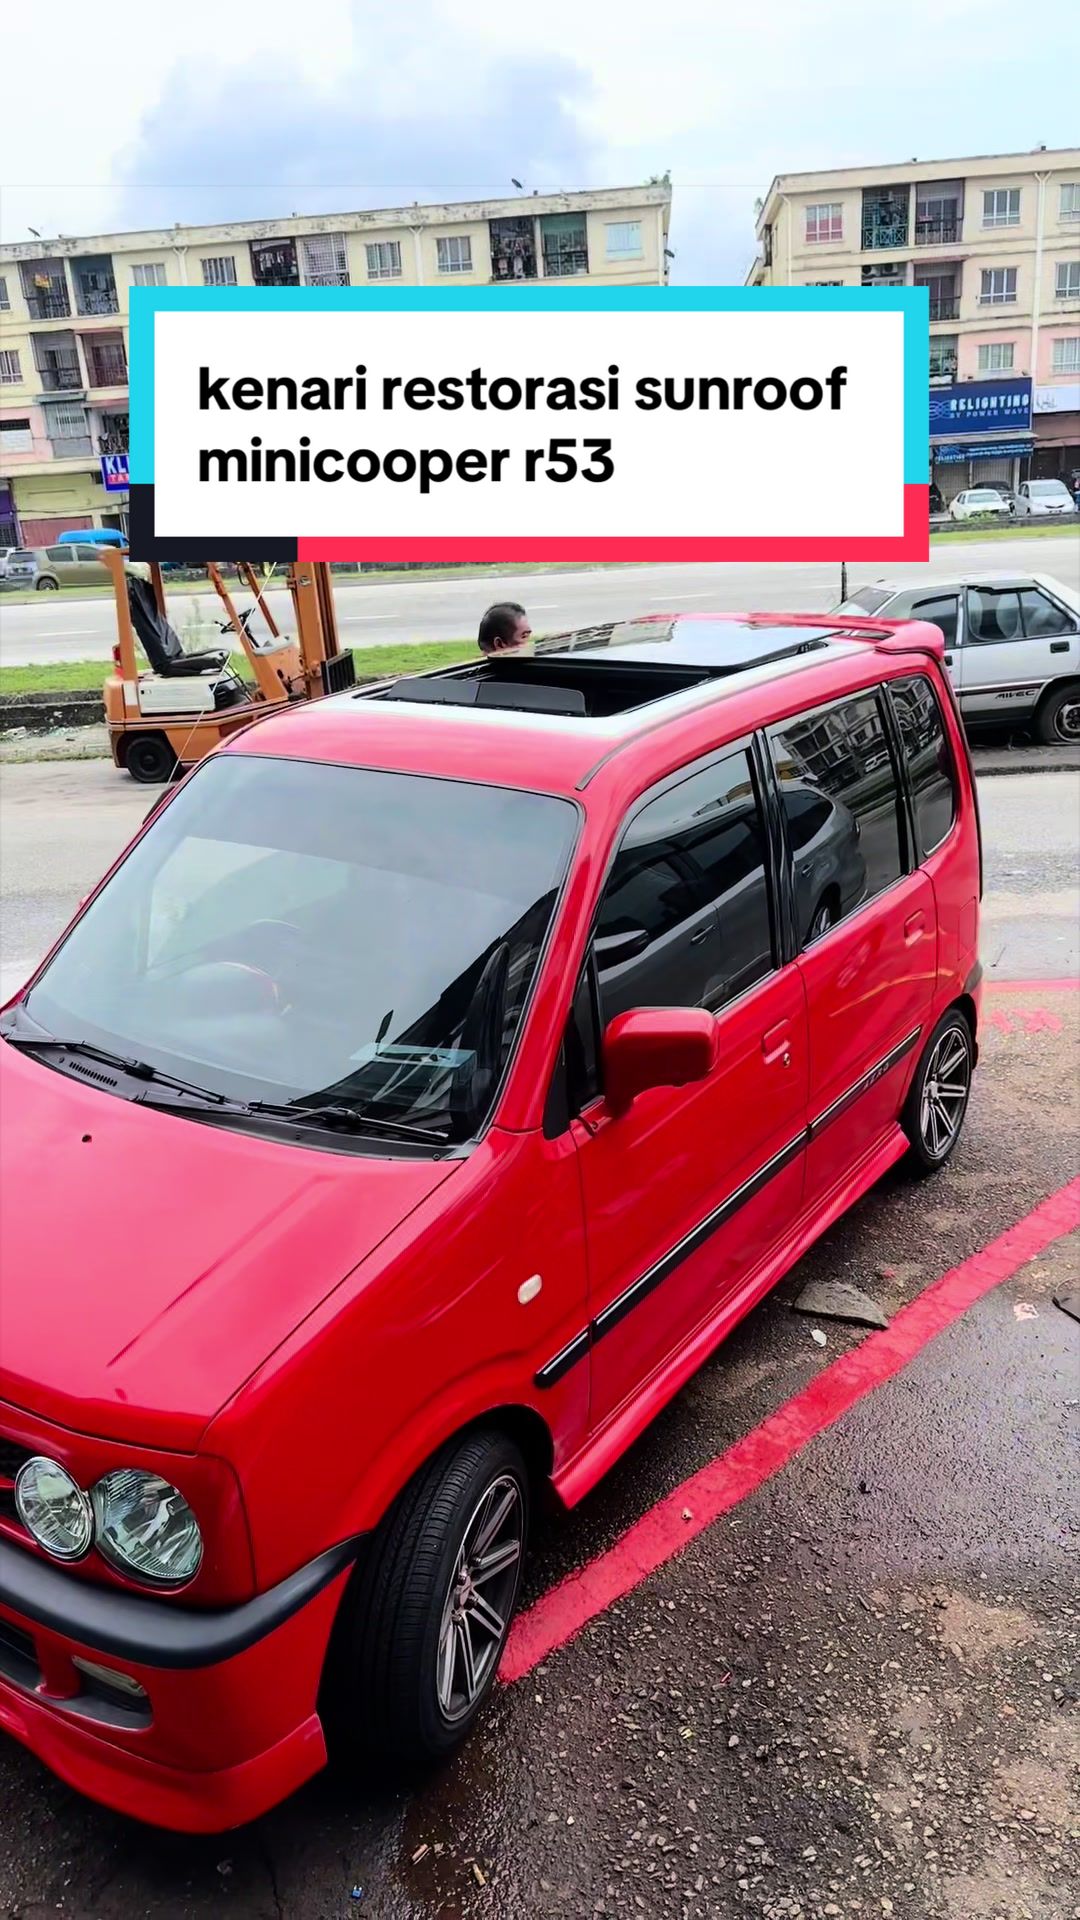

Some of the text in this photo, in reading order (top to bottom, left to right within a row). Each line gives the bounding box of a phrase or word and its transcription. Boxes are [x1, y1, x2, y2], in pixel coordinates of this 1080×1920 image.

[950, 394, 1029, 411] RELIGHTING
[966, 409, 999, 418] POWER
[1004, 407, 1029, 416] WAVE
